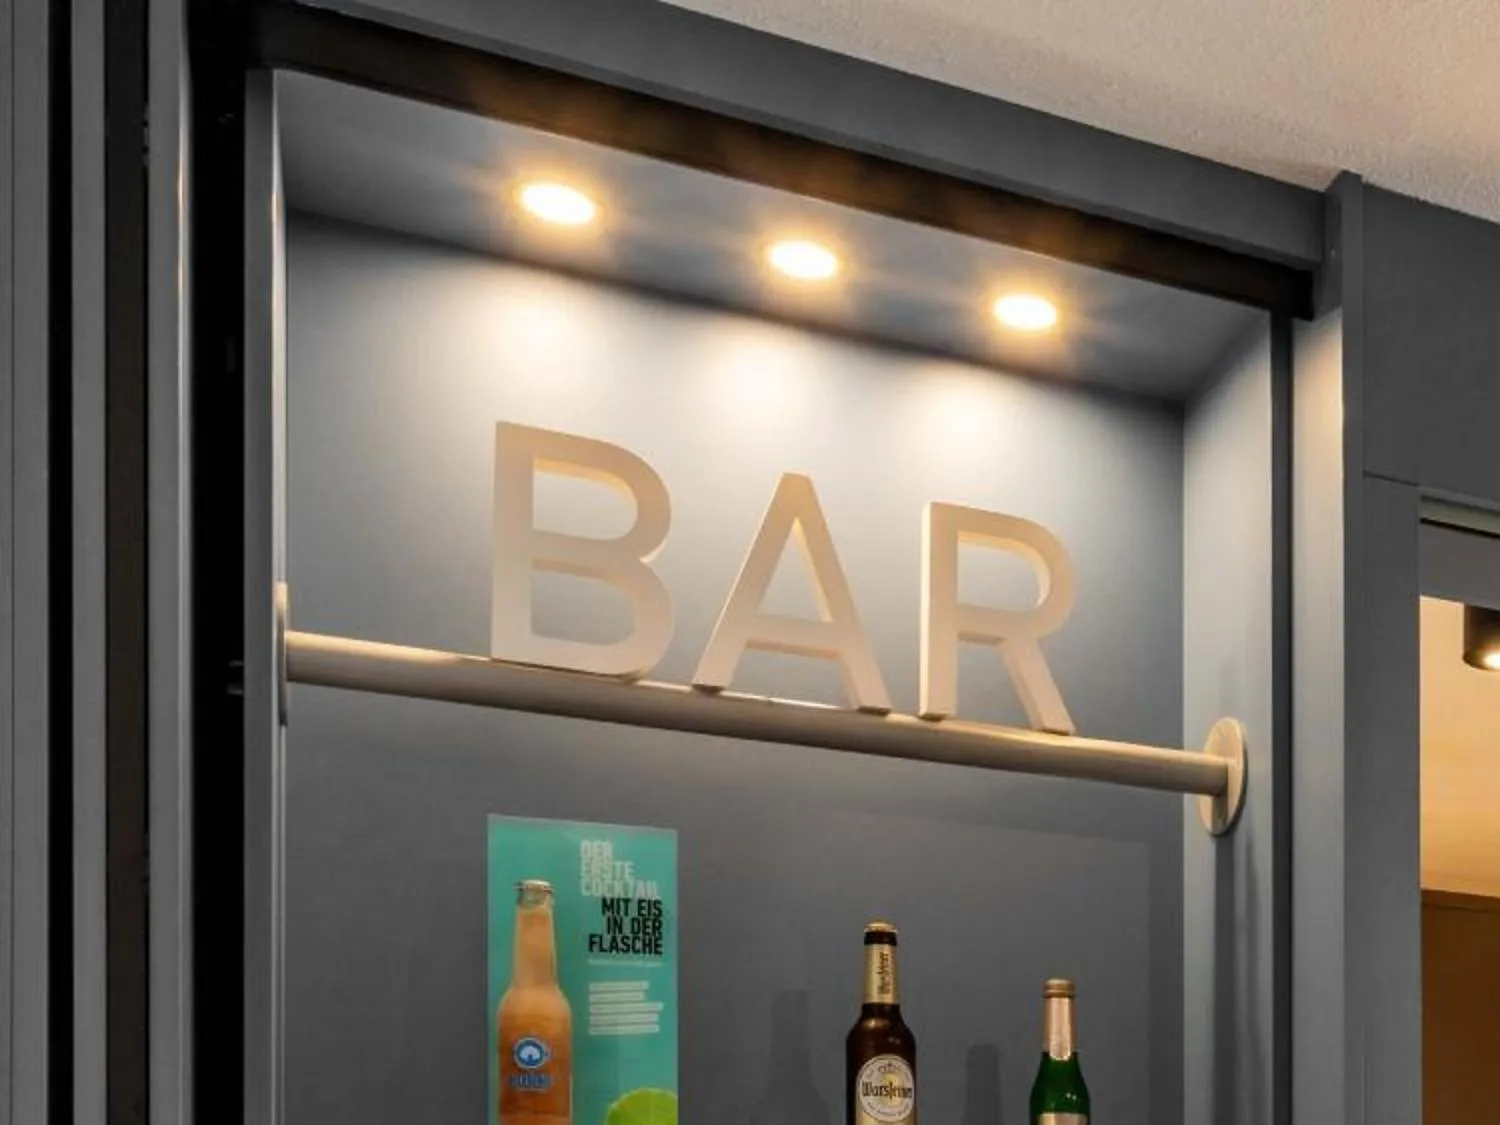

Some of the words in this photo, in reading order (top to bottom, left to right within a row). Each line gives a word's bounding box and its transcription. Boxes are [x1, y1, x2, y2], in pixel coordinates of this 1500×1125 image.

[490, 421, 1075, 735] BAR
[601, 897, 631, 917] MIT
[636, 899, 663, 918] EIS
[606, 916, 623, 935] IN
[630, 917, 663, 937] DER
[587, 933, 663, 956] FLASCHE
